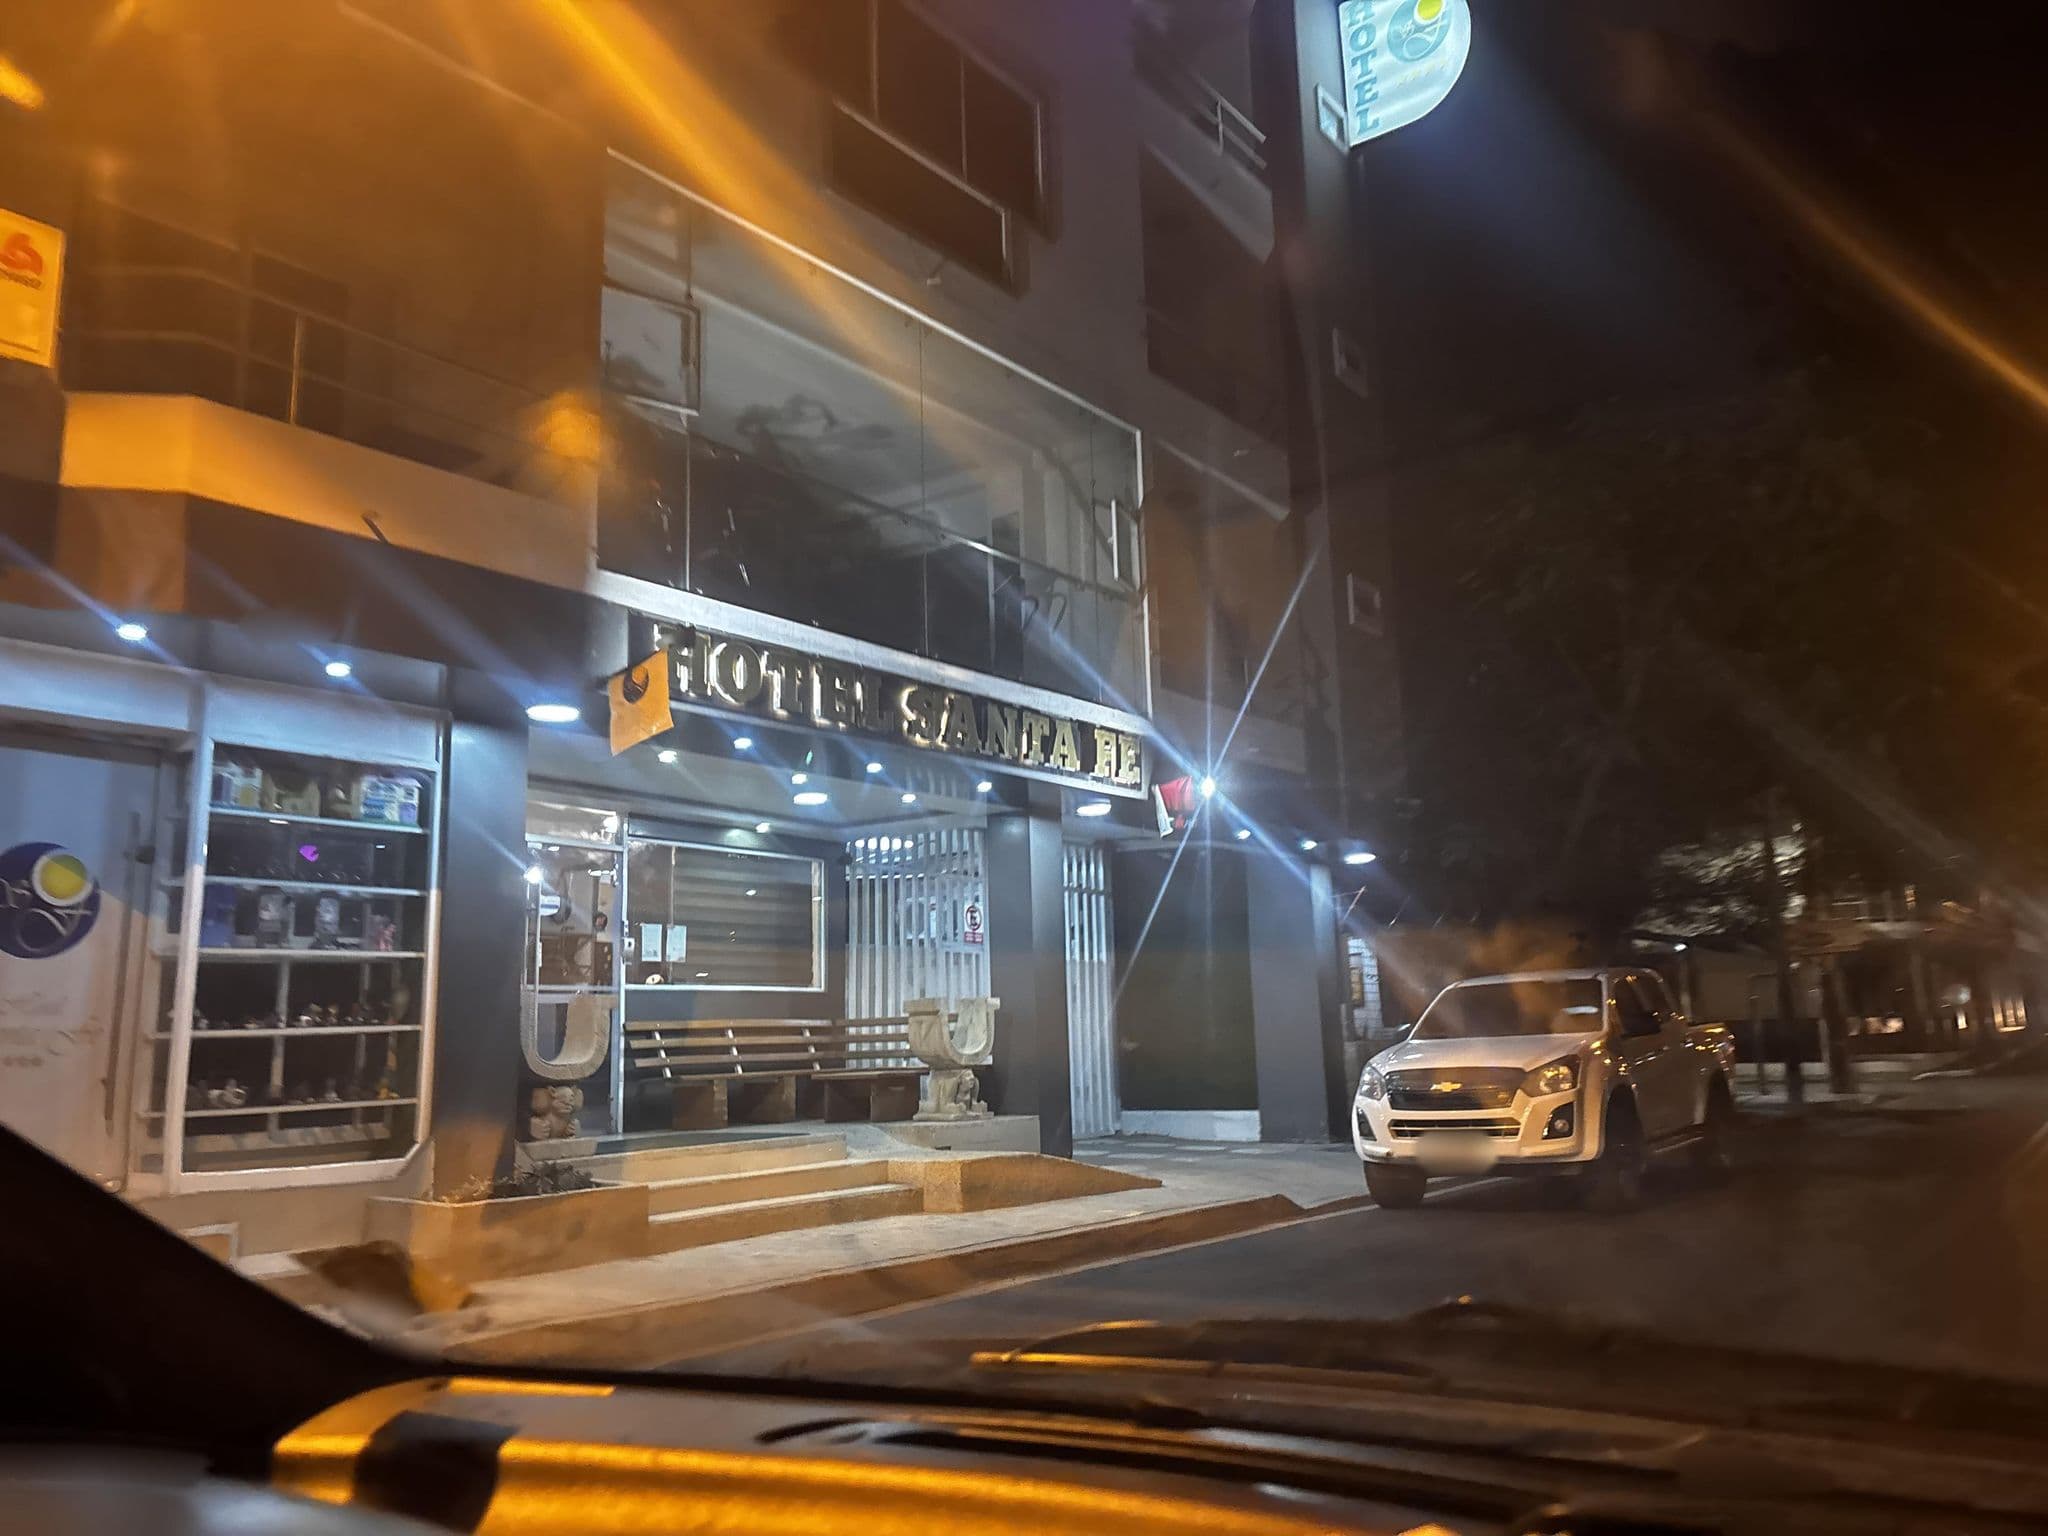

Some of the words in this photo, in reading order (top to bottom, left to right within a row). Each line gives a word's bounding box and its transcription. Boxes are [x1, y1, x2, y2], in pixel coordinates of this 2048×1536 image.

[1345, 0, 1380, 135] HOTEL
[653, 623, 895, 732] HOTEL
[900, 684, 1081, 771] SANTA
[1090, 727, 1142, 785] FE
